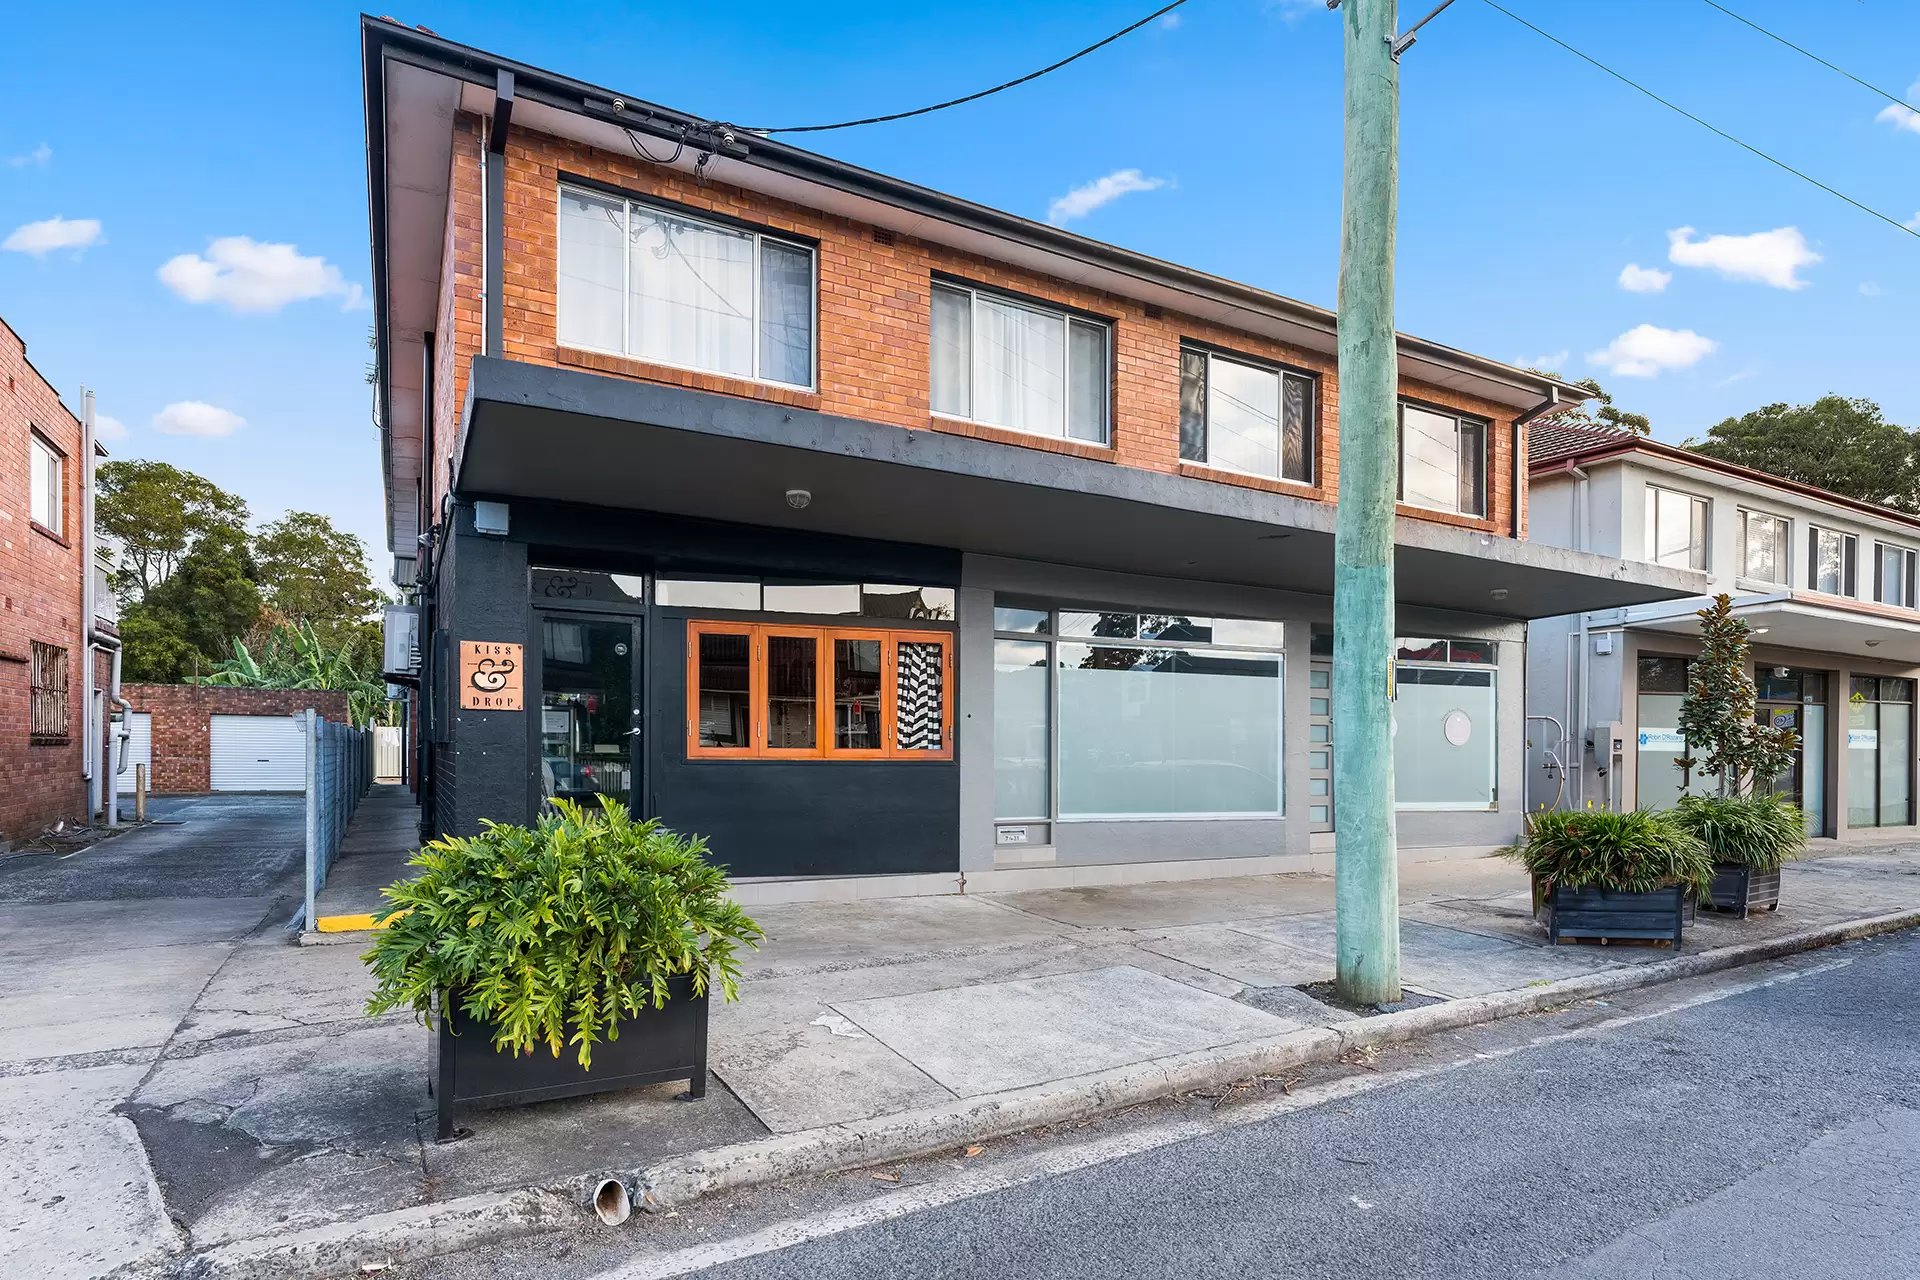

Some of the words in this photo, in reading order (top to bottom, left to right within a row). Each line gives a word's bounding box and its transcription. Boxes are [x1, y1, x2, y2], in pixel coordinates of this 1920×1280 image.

[544, 575, 578, 599] &
[474, 644, 511, 655] KISS
[471, 658, 515, 692] &
[472, 696, 514, 707] DROP
